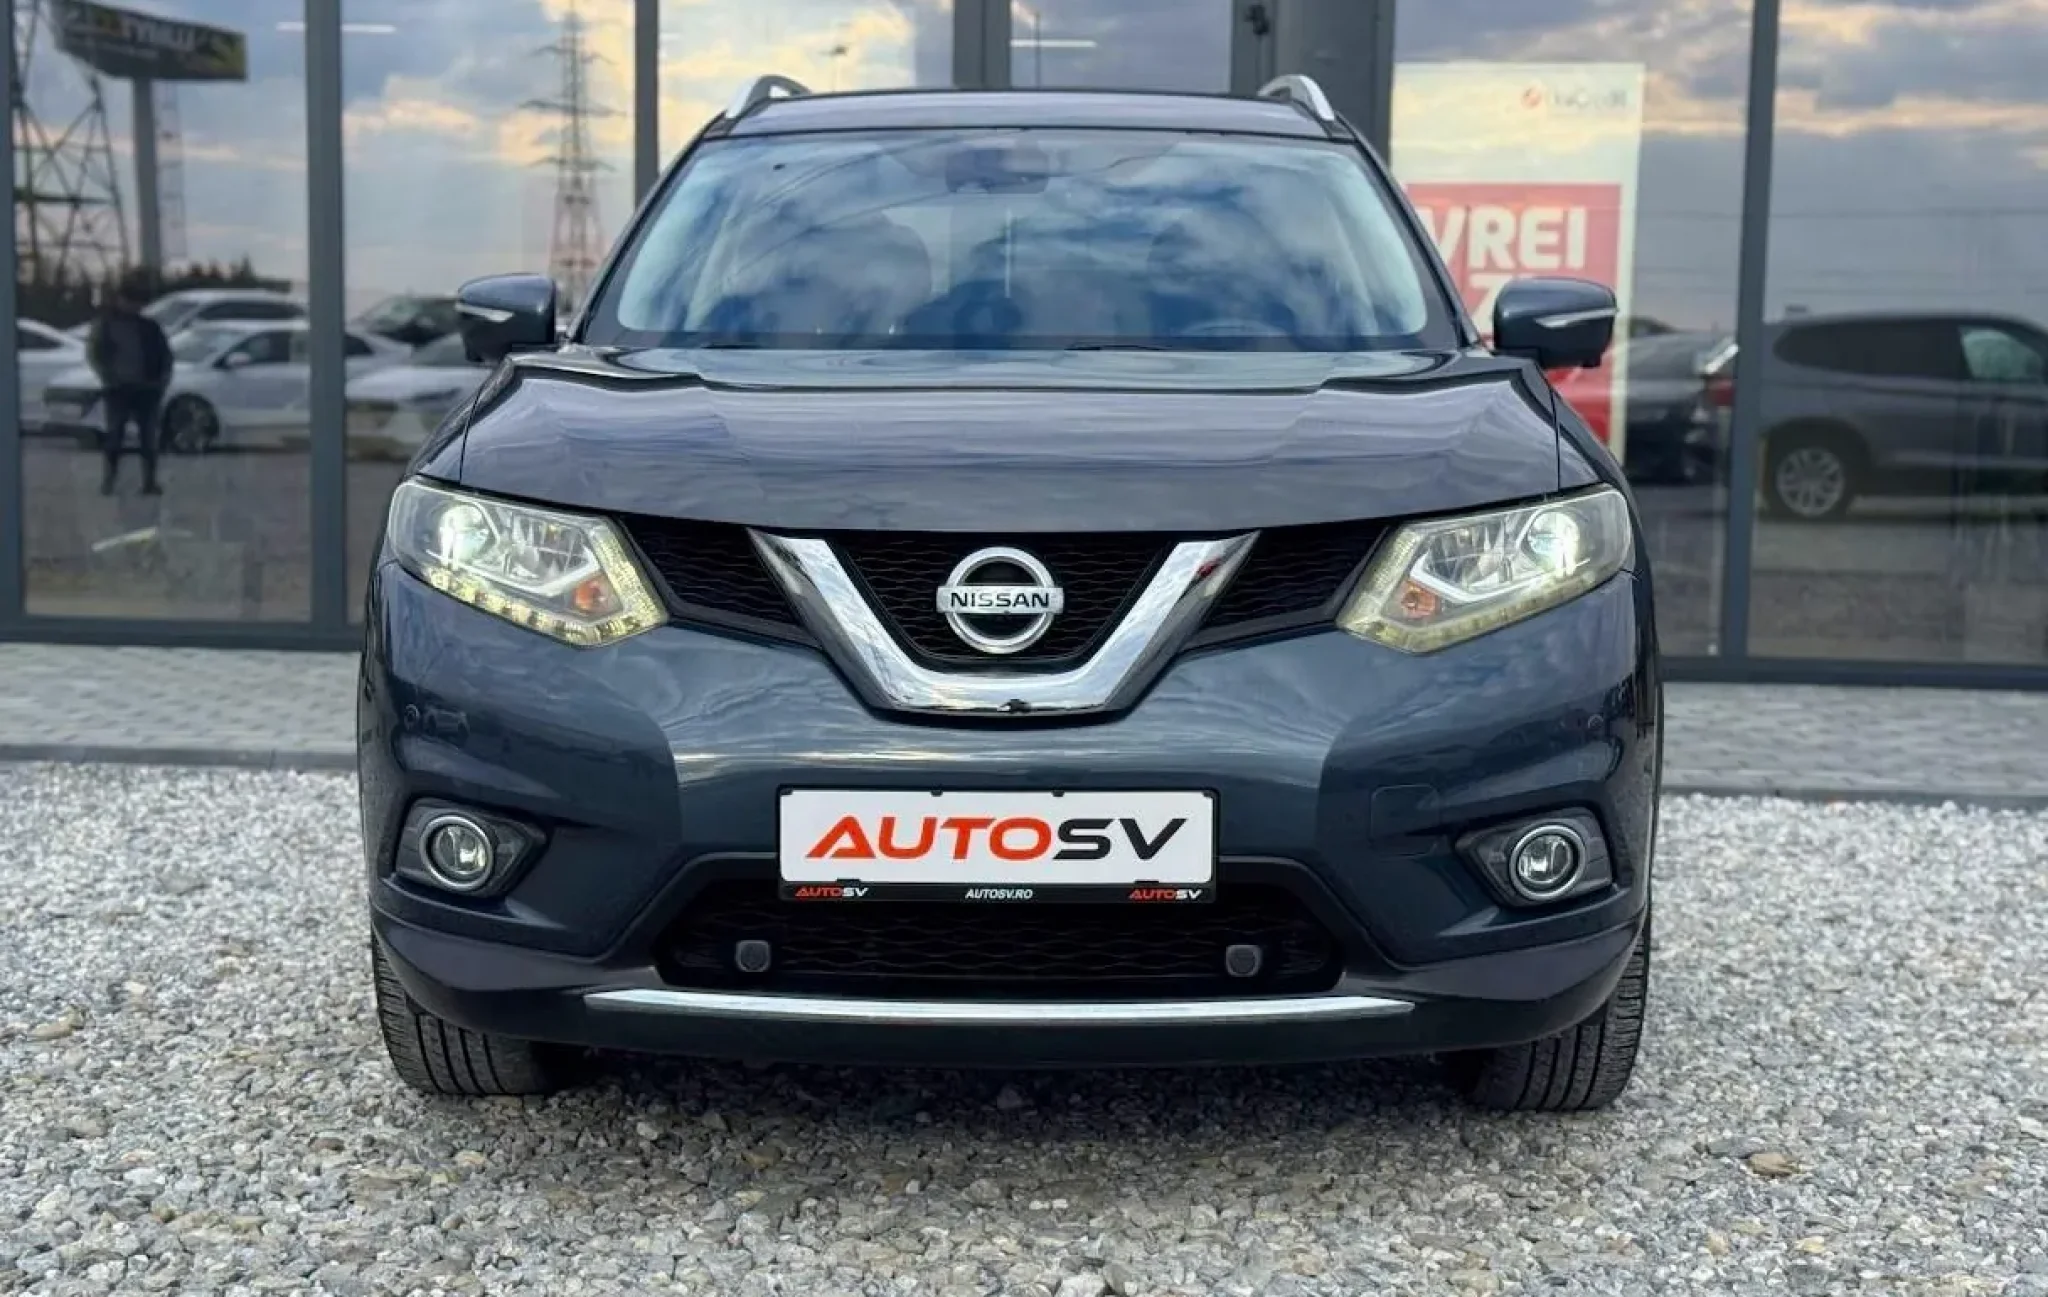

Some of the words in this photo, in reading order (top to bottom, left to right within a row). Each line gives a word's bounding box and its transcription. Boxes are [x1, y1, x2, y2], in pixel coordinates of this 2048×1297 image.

[950, 592, 1050, 608] NISSAN
[805, 816, 1187, 861] AUTOSV
[794, 887, 867, 898] AUTOSV
[965, 888, 1033, 900] AUTOSV.RO
[1130, 889, 1202, 900] AUTOSV
